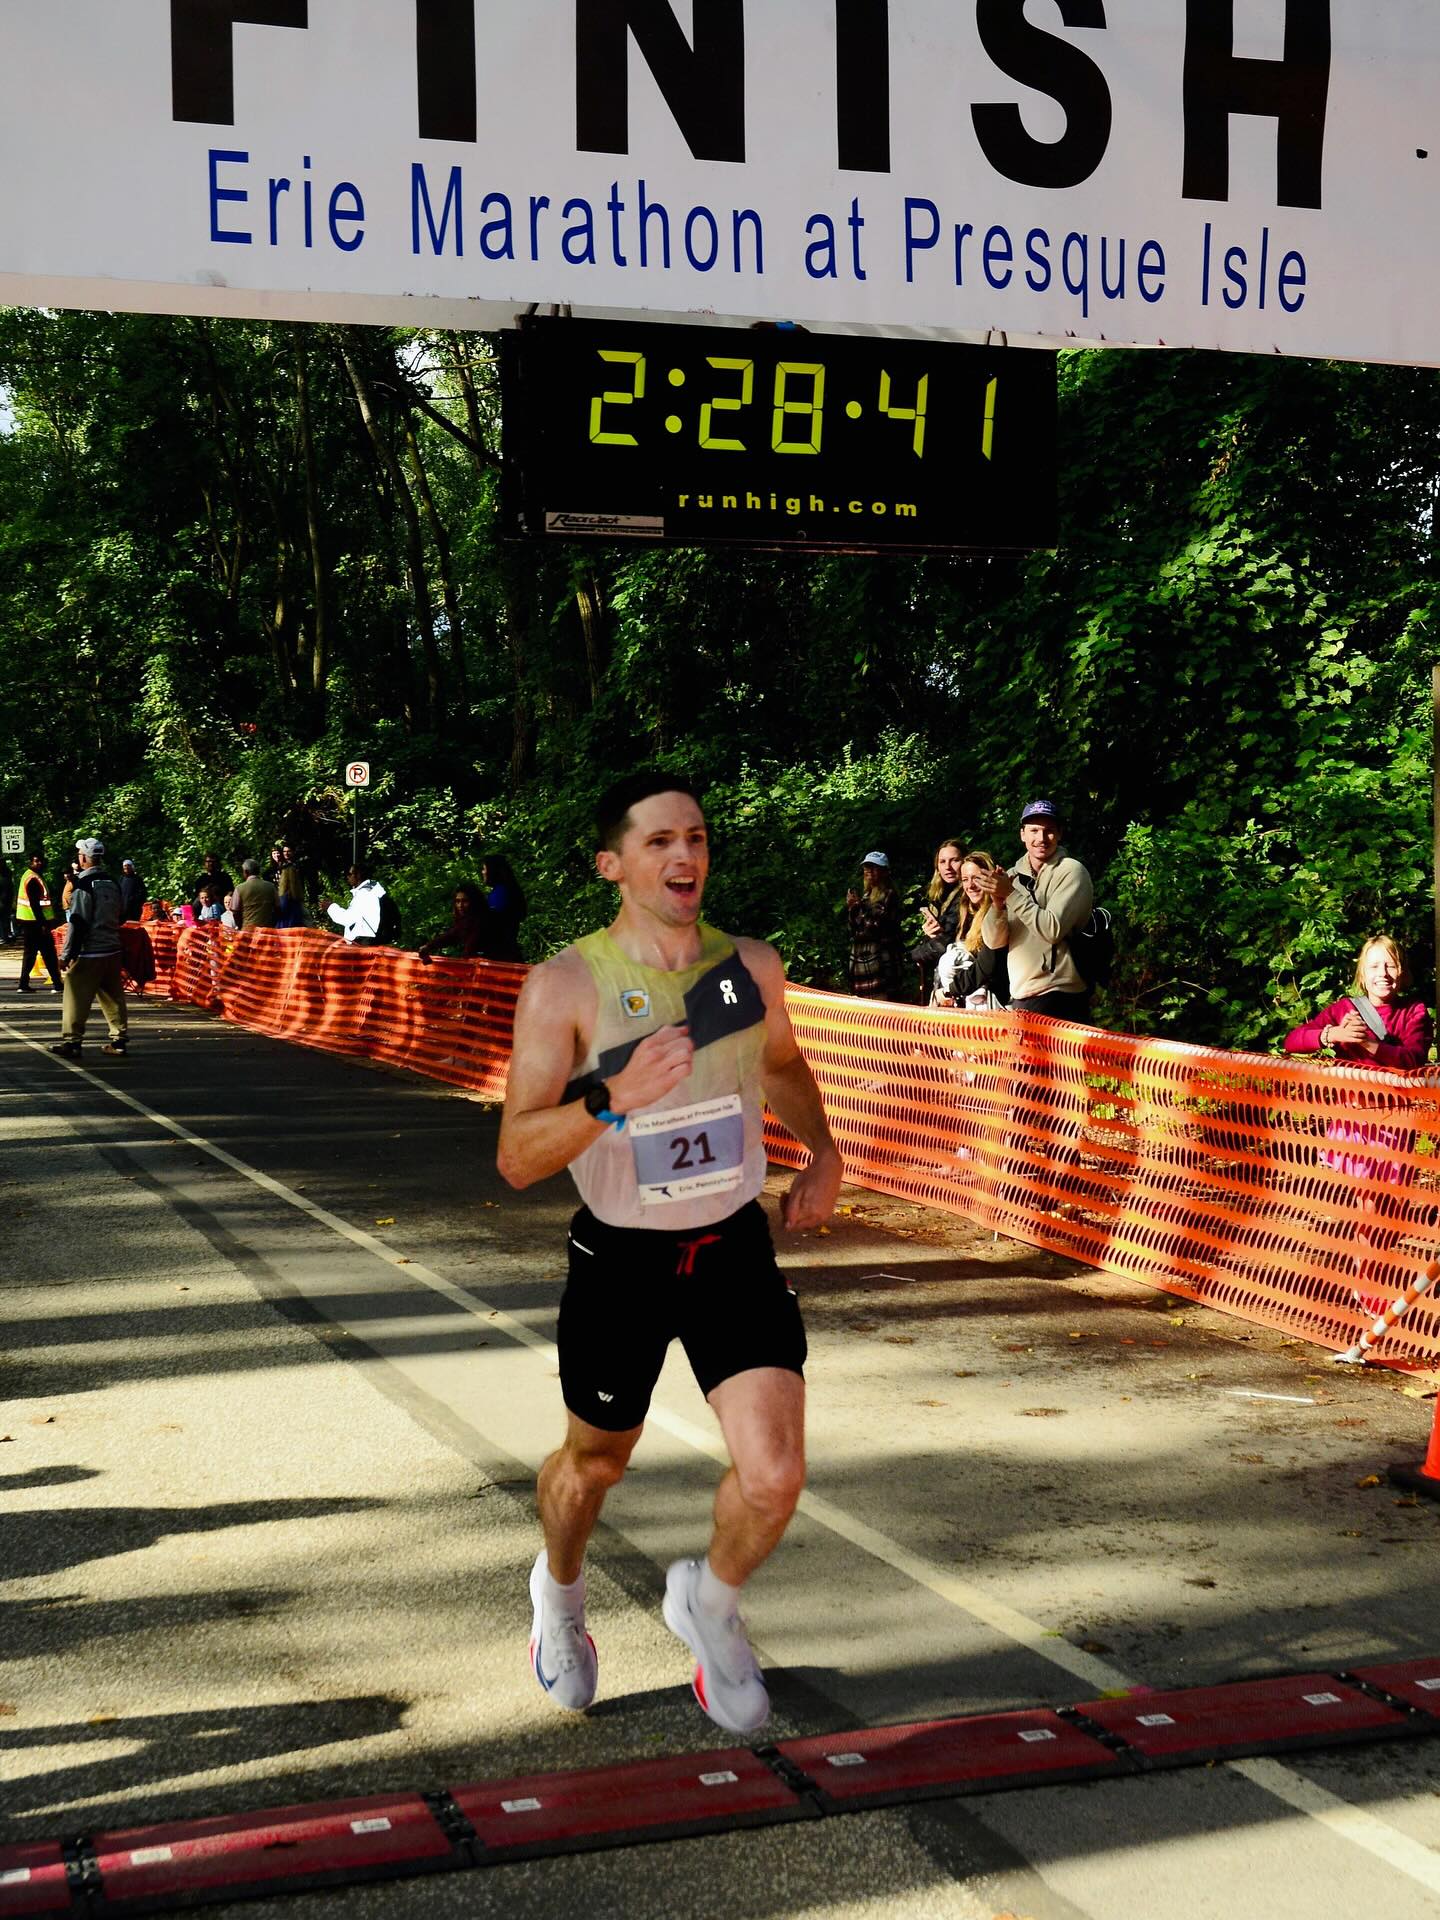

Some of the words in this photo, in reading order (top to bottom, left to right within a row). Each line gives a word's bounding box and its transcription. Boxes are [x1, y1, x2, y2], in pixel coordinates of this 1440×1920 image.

[209, 150, 365, 252] Erie
[411, 163, 764, 273] Marathon
[805, 197, 866, 281] at
[904, 197, 1165, 318] Presque
[1202, 223, 1306, 312] Isle
[679, 491, 917, 517] runhigh.com
[6, 840, 20, 851] 15
[670, 1131, 716, 1170] 21
